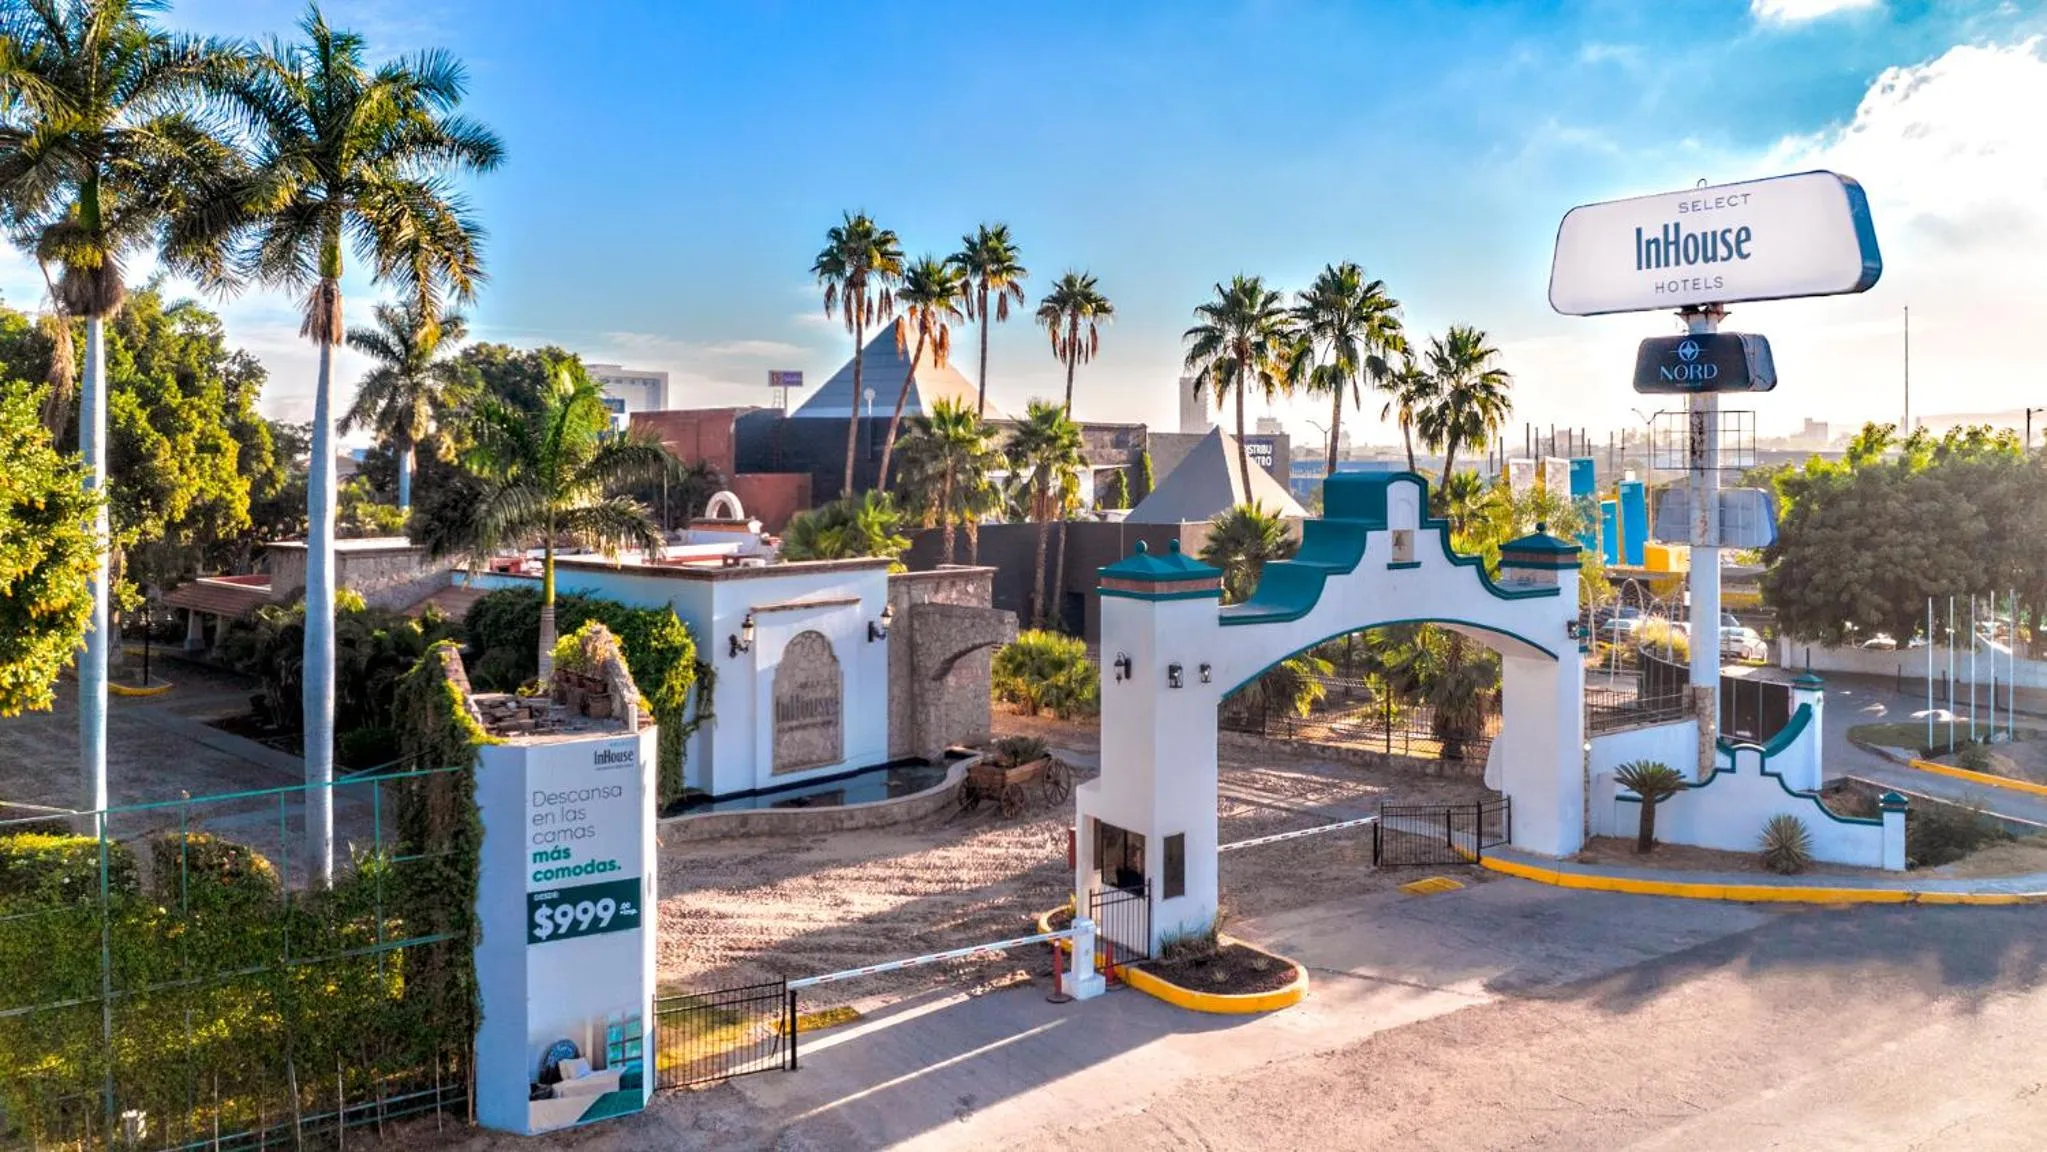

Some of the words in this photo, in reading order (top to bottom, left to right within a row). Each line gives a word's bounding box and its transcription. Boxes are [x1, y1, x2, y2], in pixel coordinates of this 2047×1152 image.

[1678, 193, 1752, 214] SELECT
[1635, 222, 1752, 271] InHouse
[1655, 276, 1724, 294] HOTELS
[1660, 363, 1717, 382] NORD
[594, 748, 634, 765] InHouse
[532, 784, 622, 808] Descansa
[532, 812, 555, 826] en
[561, 807, 586, 821] las
[532, 824, 596, 845] camas
[532, 845, 571, 864] más
[532, 858, 622, 883] comodas.
[533, 897, 616, 941] $999
